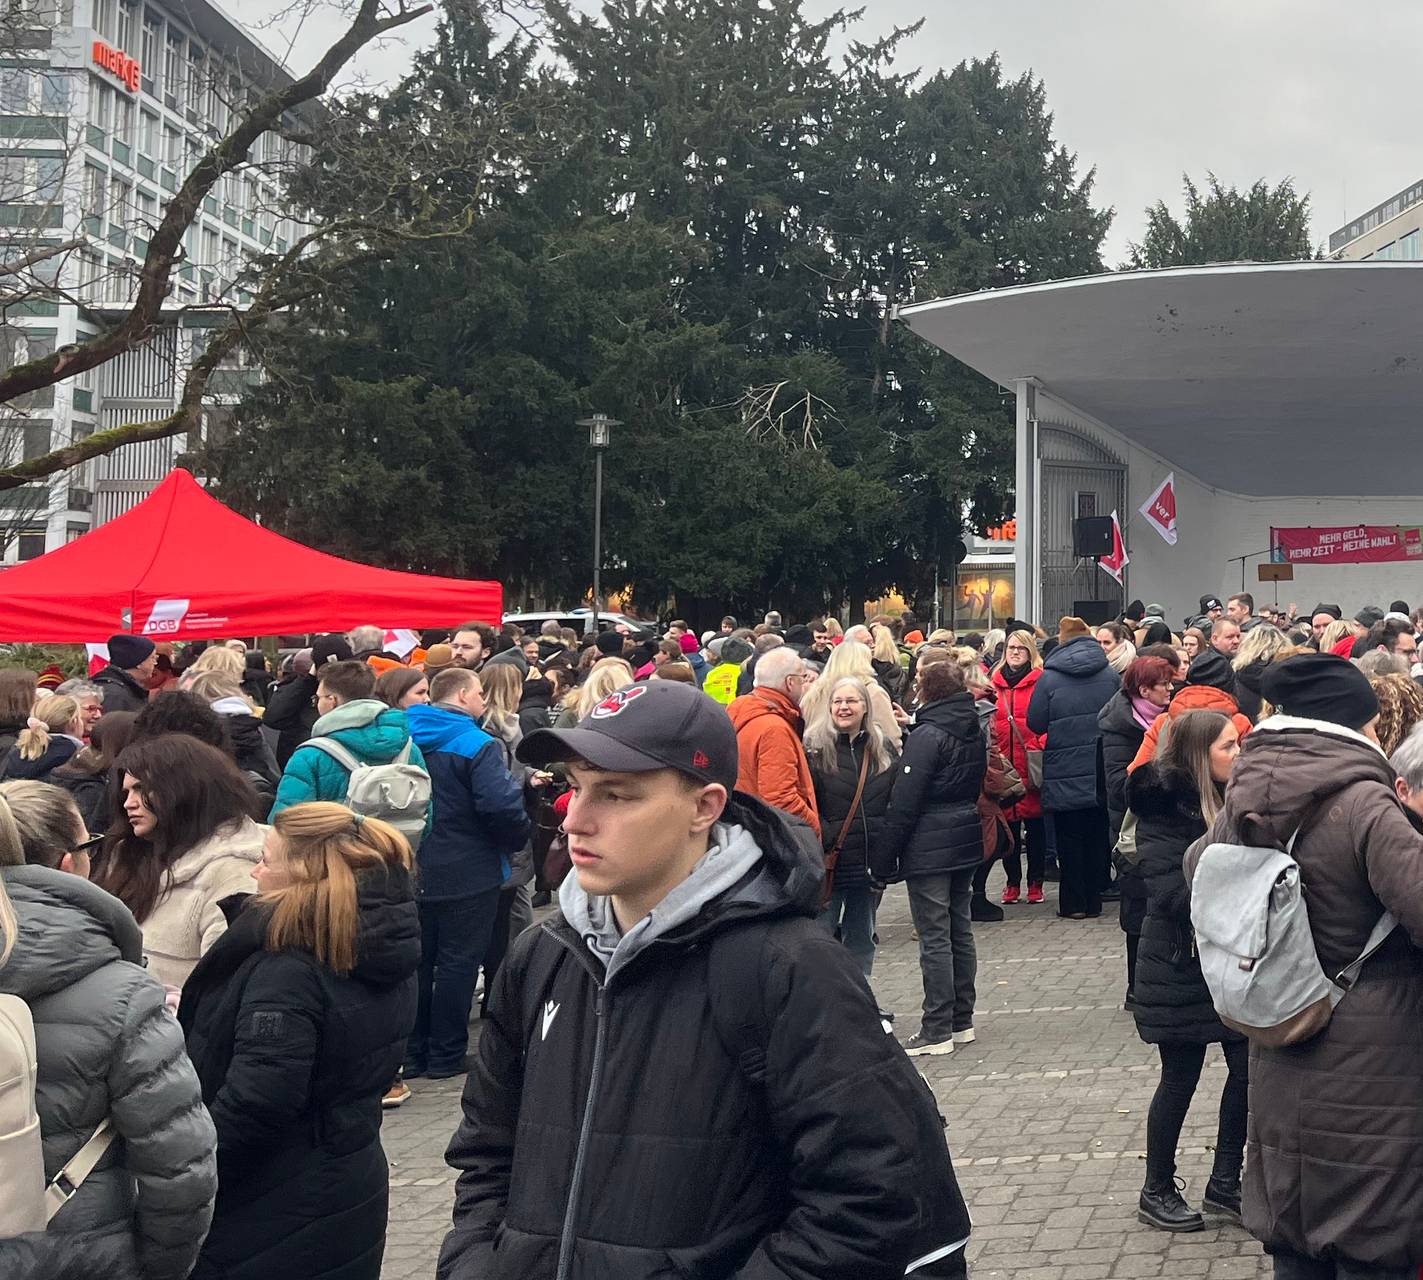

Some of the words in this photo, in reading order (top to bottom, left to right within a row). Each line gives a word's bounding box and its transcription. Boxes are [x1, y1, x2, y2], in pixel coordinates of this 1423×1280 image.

[1319, 532, 1342, 544] MEHR
[1342, 528, 1368, 541] GELD,
[1289, 547, 1312, 559] MEHR
[1312, 545, 1335, 557] ZEIT
[1343, 539, 1370, 552] MEINE
[1370, 535, 1397, 548] WAHL!
[148, 620, 177, 632] DGB
